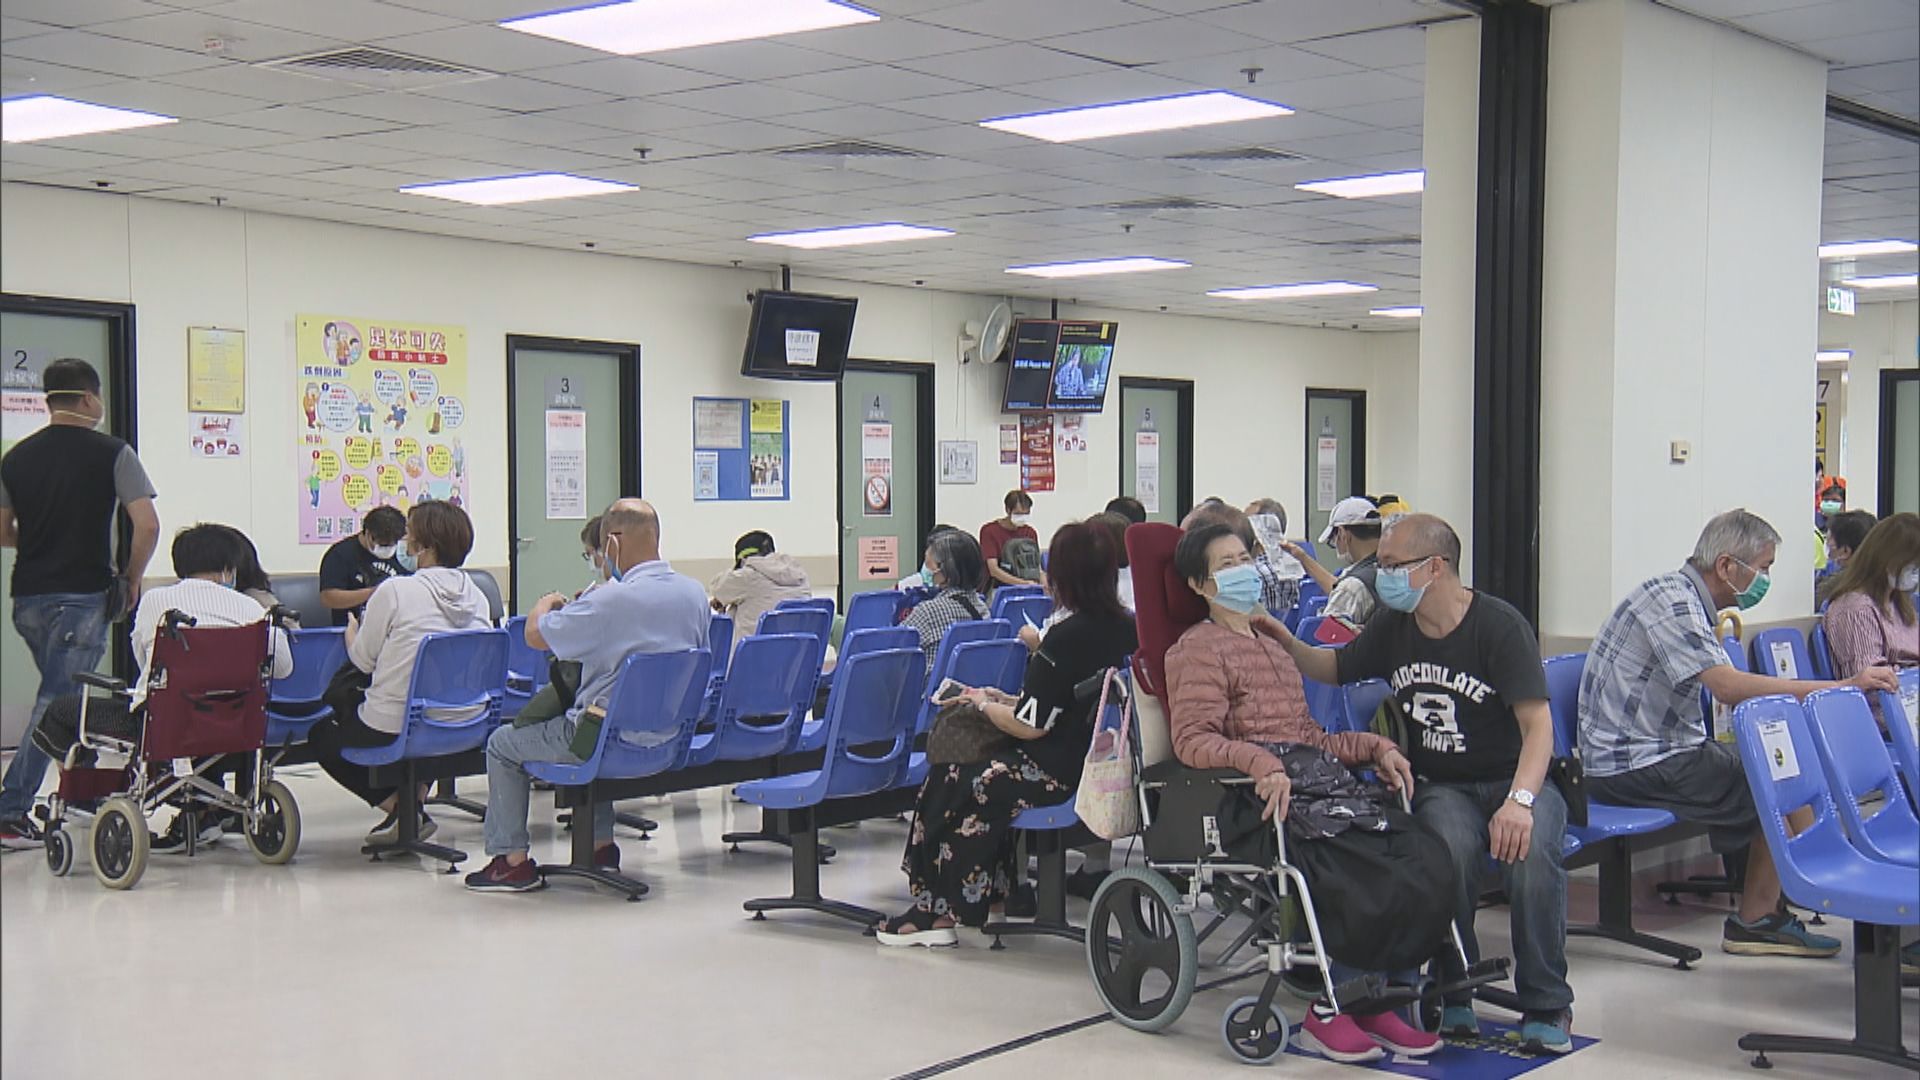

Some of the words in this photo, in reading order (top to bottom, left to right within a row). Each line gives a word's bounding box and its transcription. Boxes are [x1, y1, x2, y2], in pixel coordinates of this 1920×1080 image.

[15, 350, 28, 371] 2
[561, 377, 570, 393] 3
[873, 395, 880, 408] 4
[1144, 408, 1151, 421] 5
